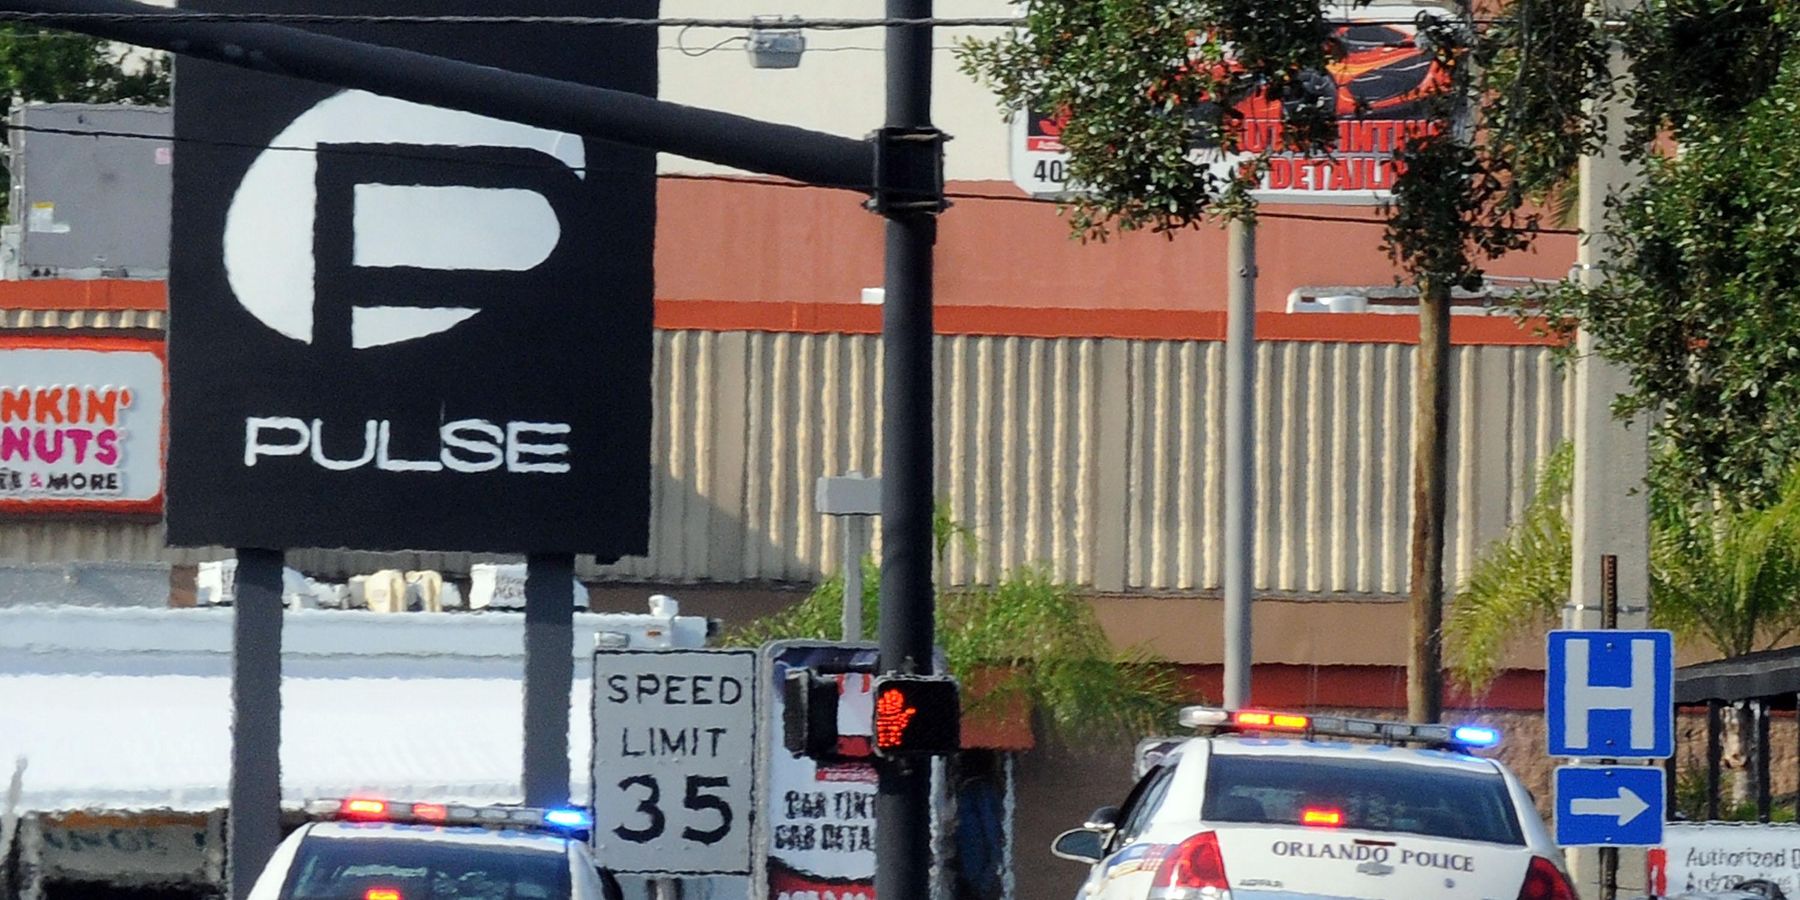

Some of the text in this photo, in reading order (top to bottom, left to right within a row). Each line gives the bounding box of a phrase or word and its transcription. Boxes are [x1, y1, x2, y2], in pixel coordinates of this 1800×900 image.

[1033, 160, 1063, 184] 40
[1, 426, 118, 465] NUTS
[244, 416, 572, 473] PULSE
[47, 472, 118, 490] MORE
[607, 674, 743, 706] SPEED
[1564, 639, 1655, 749] H
[621, 727, 727, 758] LIMIT
[612, 773, 733, 846] 35
[1272, 840, 1475, 873] ORLANDO POLICE
[1686, 846, 1786, 868] Authorized
